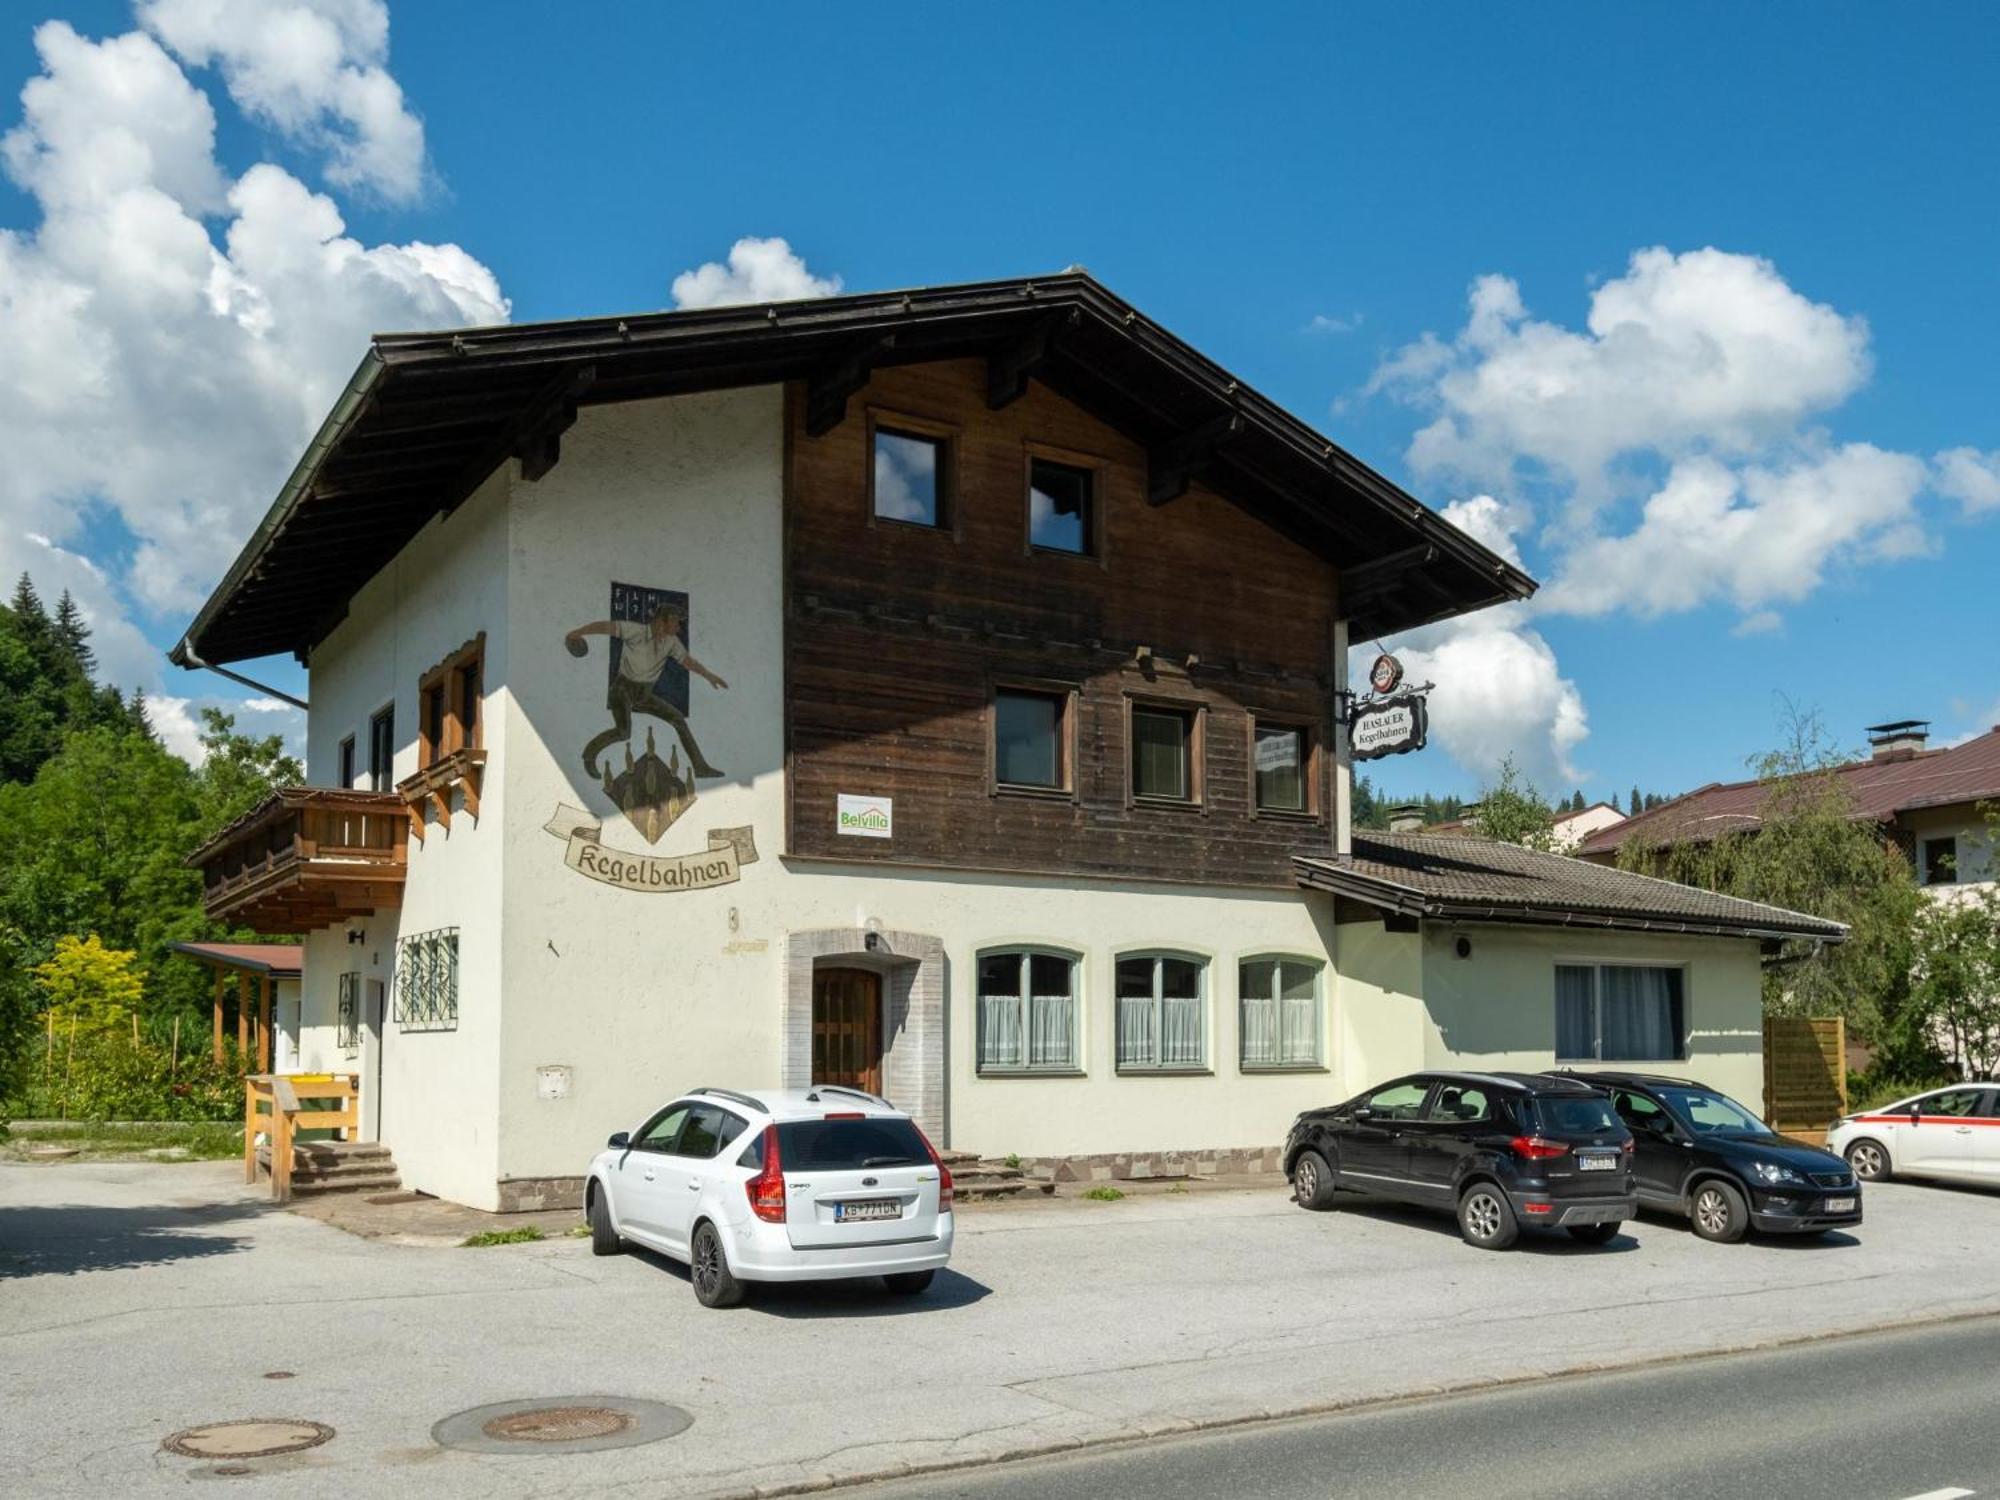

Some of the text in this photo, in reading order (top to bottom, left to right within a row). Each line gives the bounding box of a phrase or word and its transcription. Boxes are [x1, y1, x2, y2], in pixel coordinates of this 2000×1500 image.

[1363, 712, 1404, 731] HASLAUER
[1359, 726, 1408, 745] Kegelbahnen
[841, 811, 889, 828] Belvilla
[578, 845, 731, 888] Kegelbahnen
